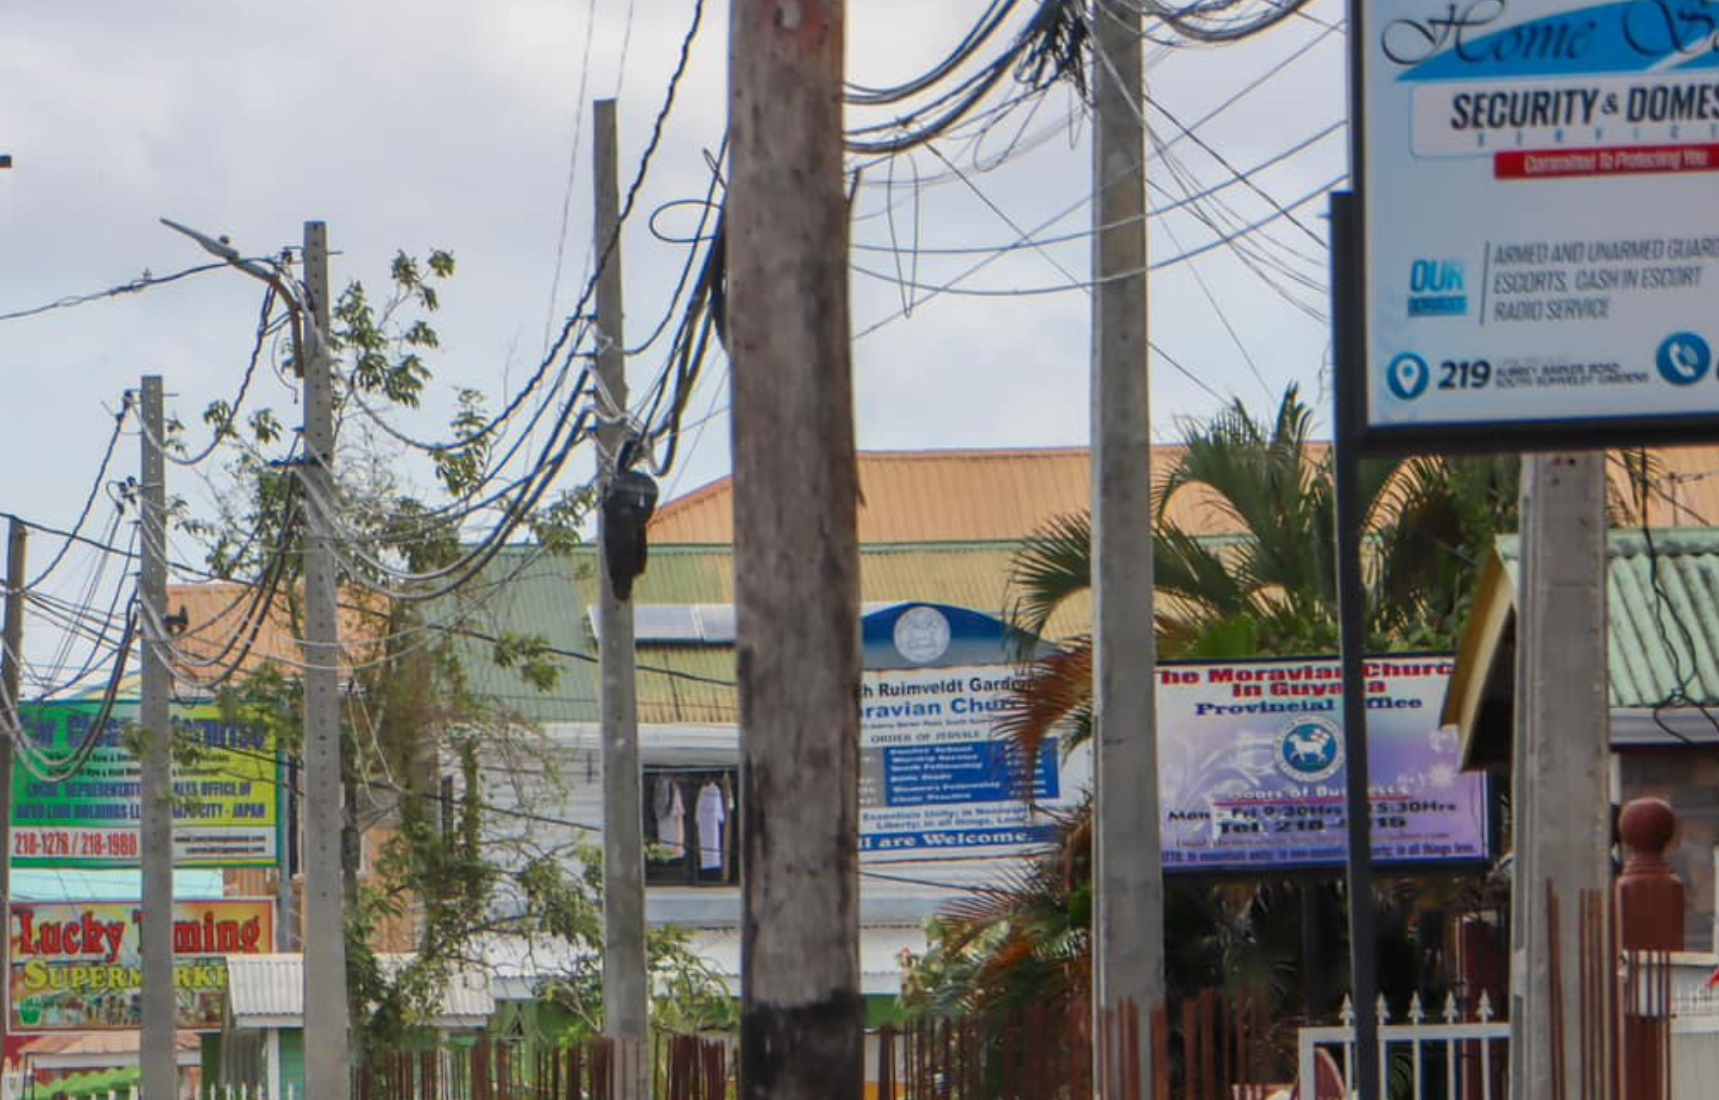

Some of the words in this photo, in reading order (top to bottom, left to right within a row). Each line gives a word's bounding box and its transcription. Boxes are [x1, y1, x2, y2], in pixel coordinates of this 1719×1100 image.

[1381, 0, 1598, 63] Home
[1451, 88, 1599, 129] SECURITY
[1601, 92, 1619, 115] &
[1494, 244, 1548, 264] ARMED
[1550, 243, 1583, 262] AND
[1587, 240, 1662, 261] UNARMED
[1410, 259, 1465, 292] OUR
[1575, 269, 1617, 290] CASH
[1621, 268, 1638, 288] IN
[1642, 266, 1701, 288] ESCORT
[1494, 300, 1543, 321] RADIO
[1546, 299, 1610, 321] SERVICE
[1438, 360, 1491, 389] 219
[1160, 669, 1200, 684] he
[879, 679, 964, 697] Ruimveldt
[1270, 680, 1386, 697] Guyaa
[859, 699, 941, 719] ravian
[1195, 699, 1335, 716] Provincial
[1365, 697, 1423, 710] ffice
[201, 781, 236, 796] OFFICE
[1168, 809, 1211, 822] Mon
[879, 836, 916, 848] are
[922, 831, 1033, 846] Welcome.
[14, 908, 126, 965] Lucky
[133, 911, 262, 956] ming
